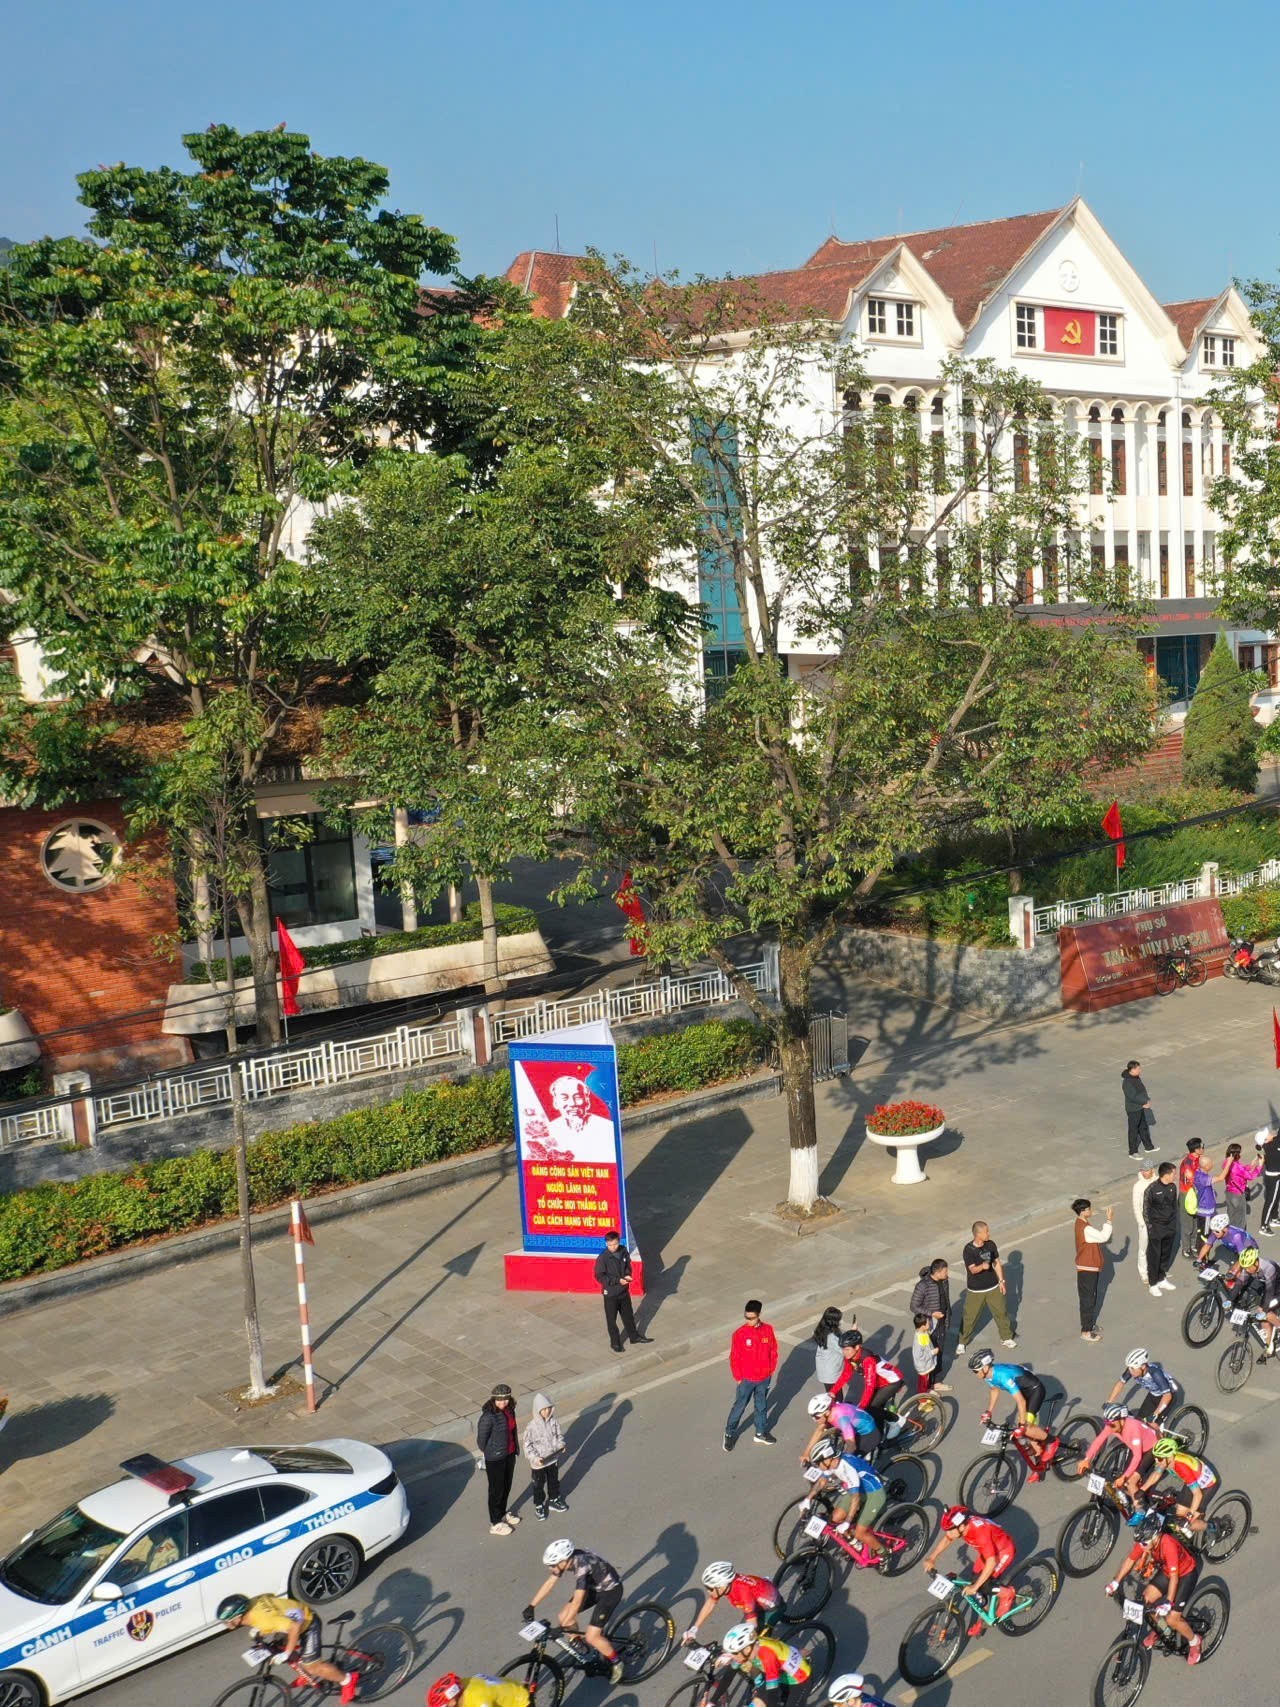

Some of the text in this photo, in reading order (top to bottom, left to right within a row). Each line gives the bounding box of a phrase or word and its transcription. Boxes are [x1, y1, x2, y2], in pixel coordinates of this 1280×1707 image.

[580, 1166, 594, 1180] VIỆT
[595, 1168, 609, 1178] NAM
[582, 1215, 596, 1230] VIỆT
[597, 1217, 611, 1227] NAM
[21, 1501, 356, 1658] CẢNH SÁT GIAO THÔNG
[92, 1627, 126, 1648] TRAFFIC
[154, 1601, 183, 1619] POLICE
